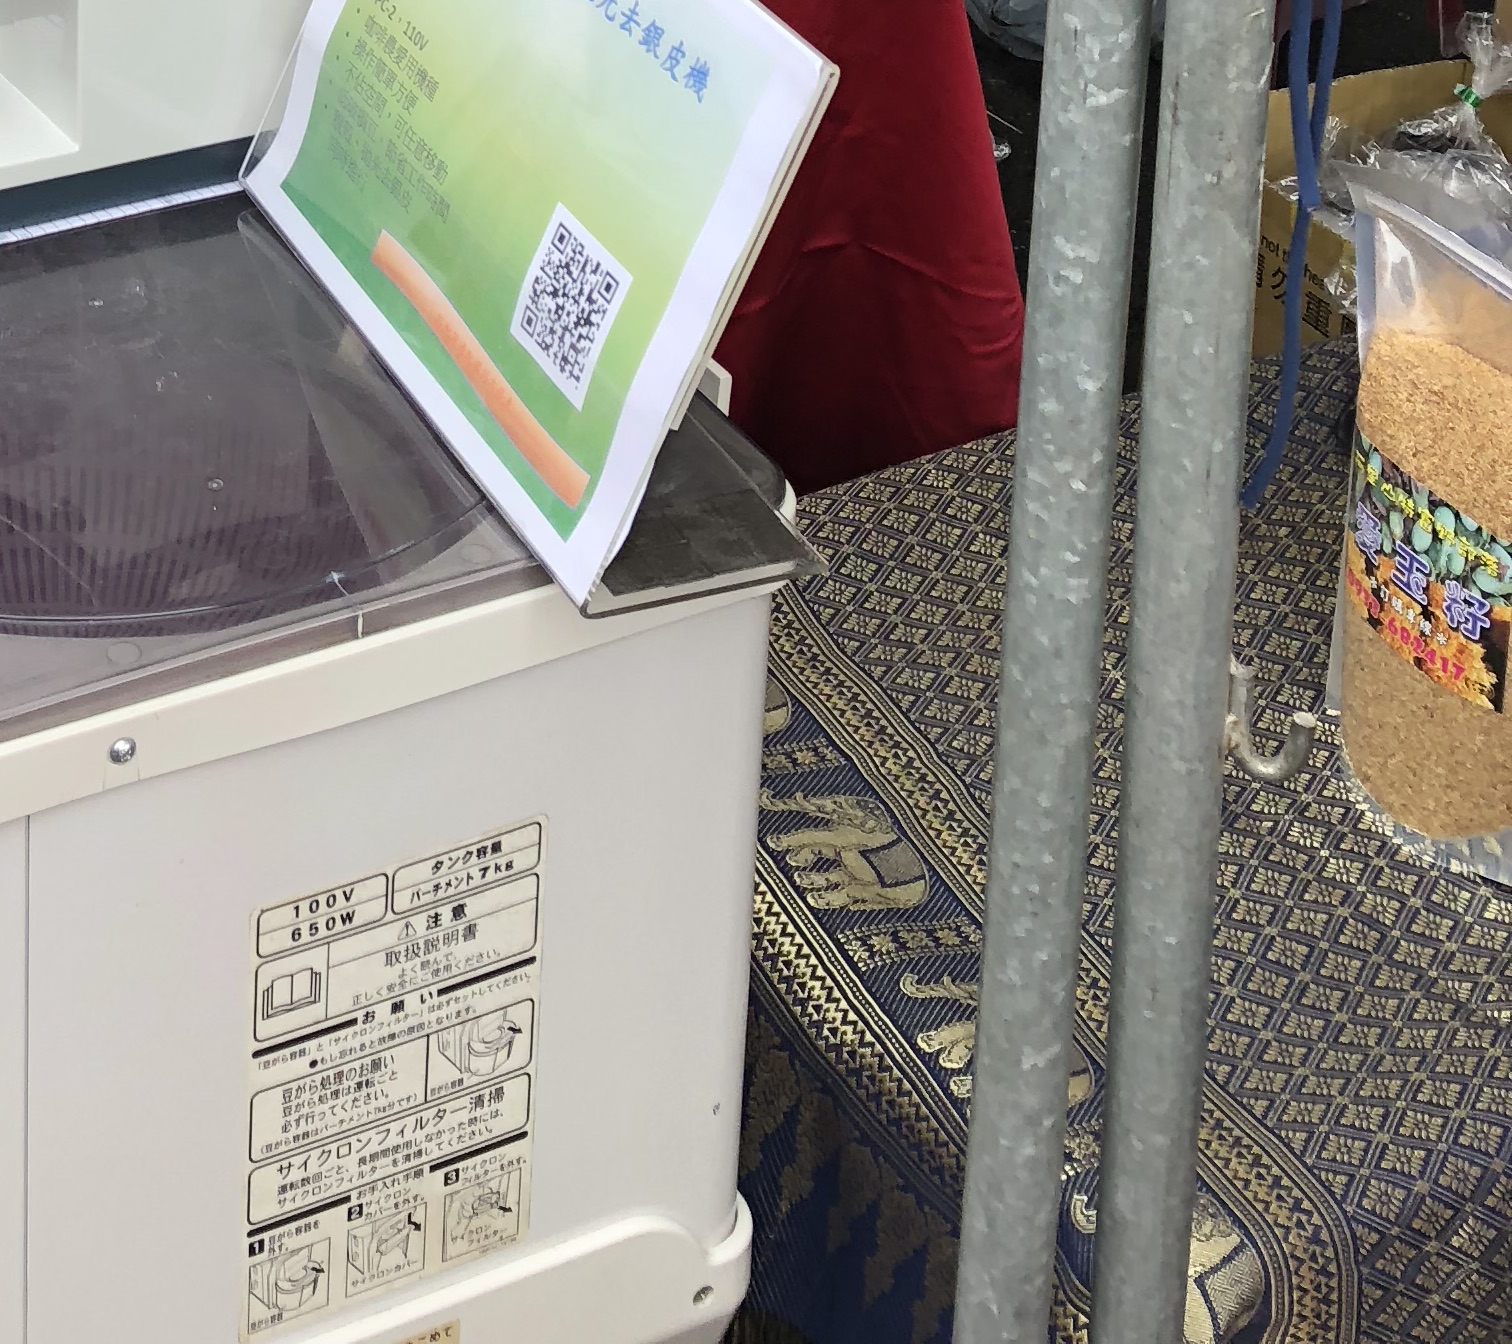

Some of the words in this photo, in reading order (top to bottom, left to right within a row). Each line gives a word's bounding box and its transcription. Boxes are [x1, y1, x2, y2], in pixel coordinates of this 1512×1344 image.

[364, 14, 440, 103] 咖啡農愛用機種
[352, 36, 420, 117] 操作簡單方便
[1355, 502, 1491, 642] 愛玉籽
[431, 840, 503, 875] タンク容量
[293, 887, 356, 919] 100V
[426, 903, 468, 930] 注意
[291, 910, 356, 943] 650W
[385, 923, 479, 968] 取扱説明書
[362, 992, 434, 1024] お願い
[281, 1054, 396, 1106] 豆がら処理のお願い
[281, 1070, 399, 1119] 豆がら処理は運転ごと
[281, 1089, 390, 1135] 必ず行ってください。
[277, 1086, 506, 1180] サイクロンフィルター清掃
[356, 1167, 425, 1201] お手入れ手順
[447, 1171, 457, 1184] 3
[461, 1152, 508, 1176] サイクロン
[352, 1207, 361, 1219] 2
[365, 1187, 412, 1210] サイクロン
[252, 1242, 261, 1255] 1
[351, 1258, 418, 1288] サイクロンカバー
